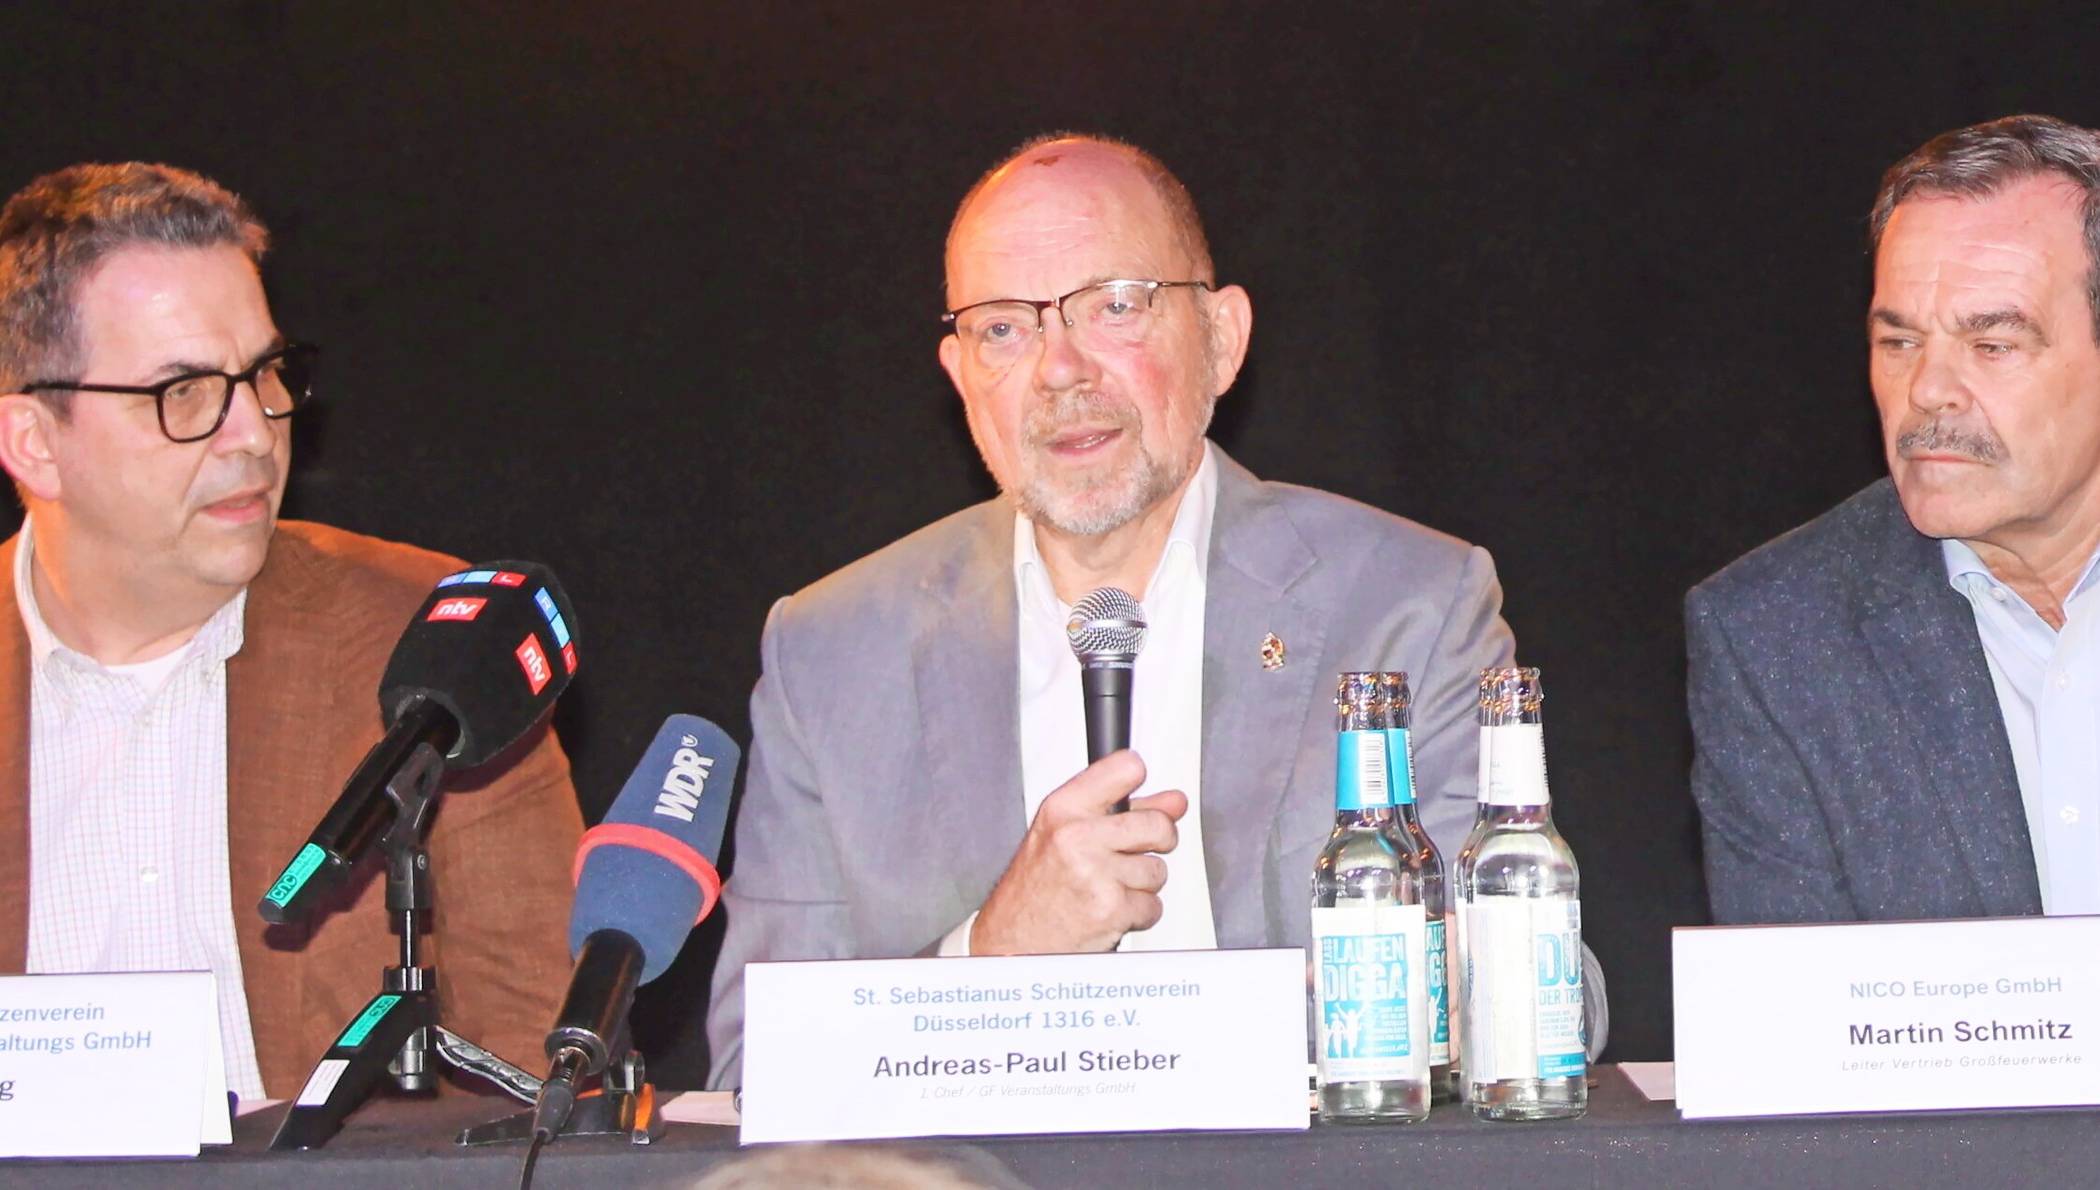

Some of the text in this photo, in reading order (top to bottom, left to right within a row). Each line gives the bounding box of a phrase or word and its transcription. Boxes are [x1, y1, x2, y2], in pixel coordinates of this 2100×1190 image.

[437, 601, 478, 616] ntv
[524, 646, 546, 682] ntv
[654, 747, 715, 823] WDR
[853, 979, 1201, 1006] St. Sebastianus Schützenverein
[1323, 963, 1407, 1001] DIGGA
[1849, 977, 2063, 999] NICO Europe GmbH
[0, 1003, 105, 1022] zenverein
[913, 1008, 1141, 1033] Düsseldorf 1316 e.V.
[0, 1031, 153, 1055] altungs GmbH
[1849, 1017, 2074, 1046] Martin Schmitz
[873, 1048, 1182, 1078] Andreas-Paul Stieber
[1841, 1053, 2083, 1072] Leiter Vertrieb Großfeuerwerke
[934, 1085, 965, 1100] Chef
[979, 1084, 997, 1098] GF
[1000, 1082, 1091, 1098] Veranstaltungs
[1095, 1081, 1136, 1095] GmbH
